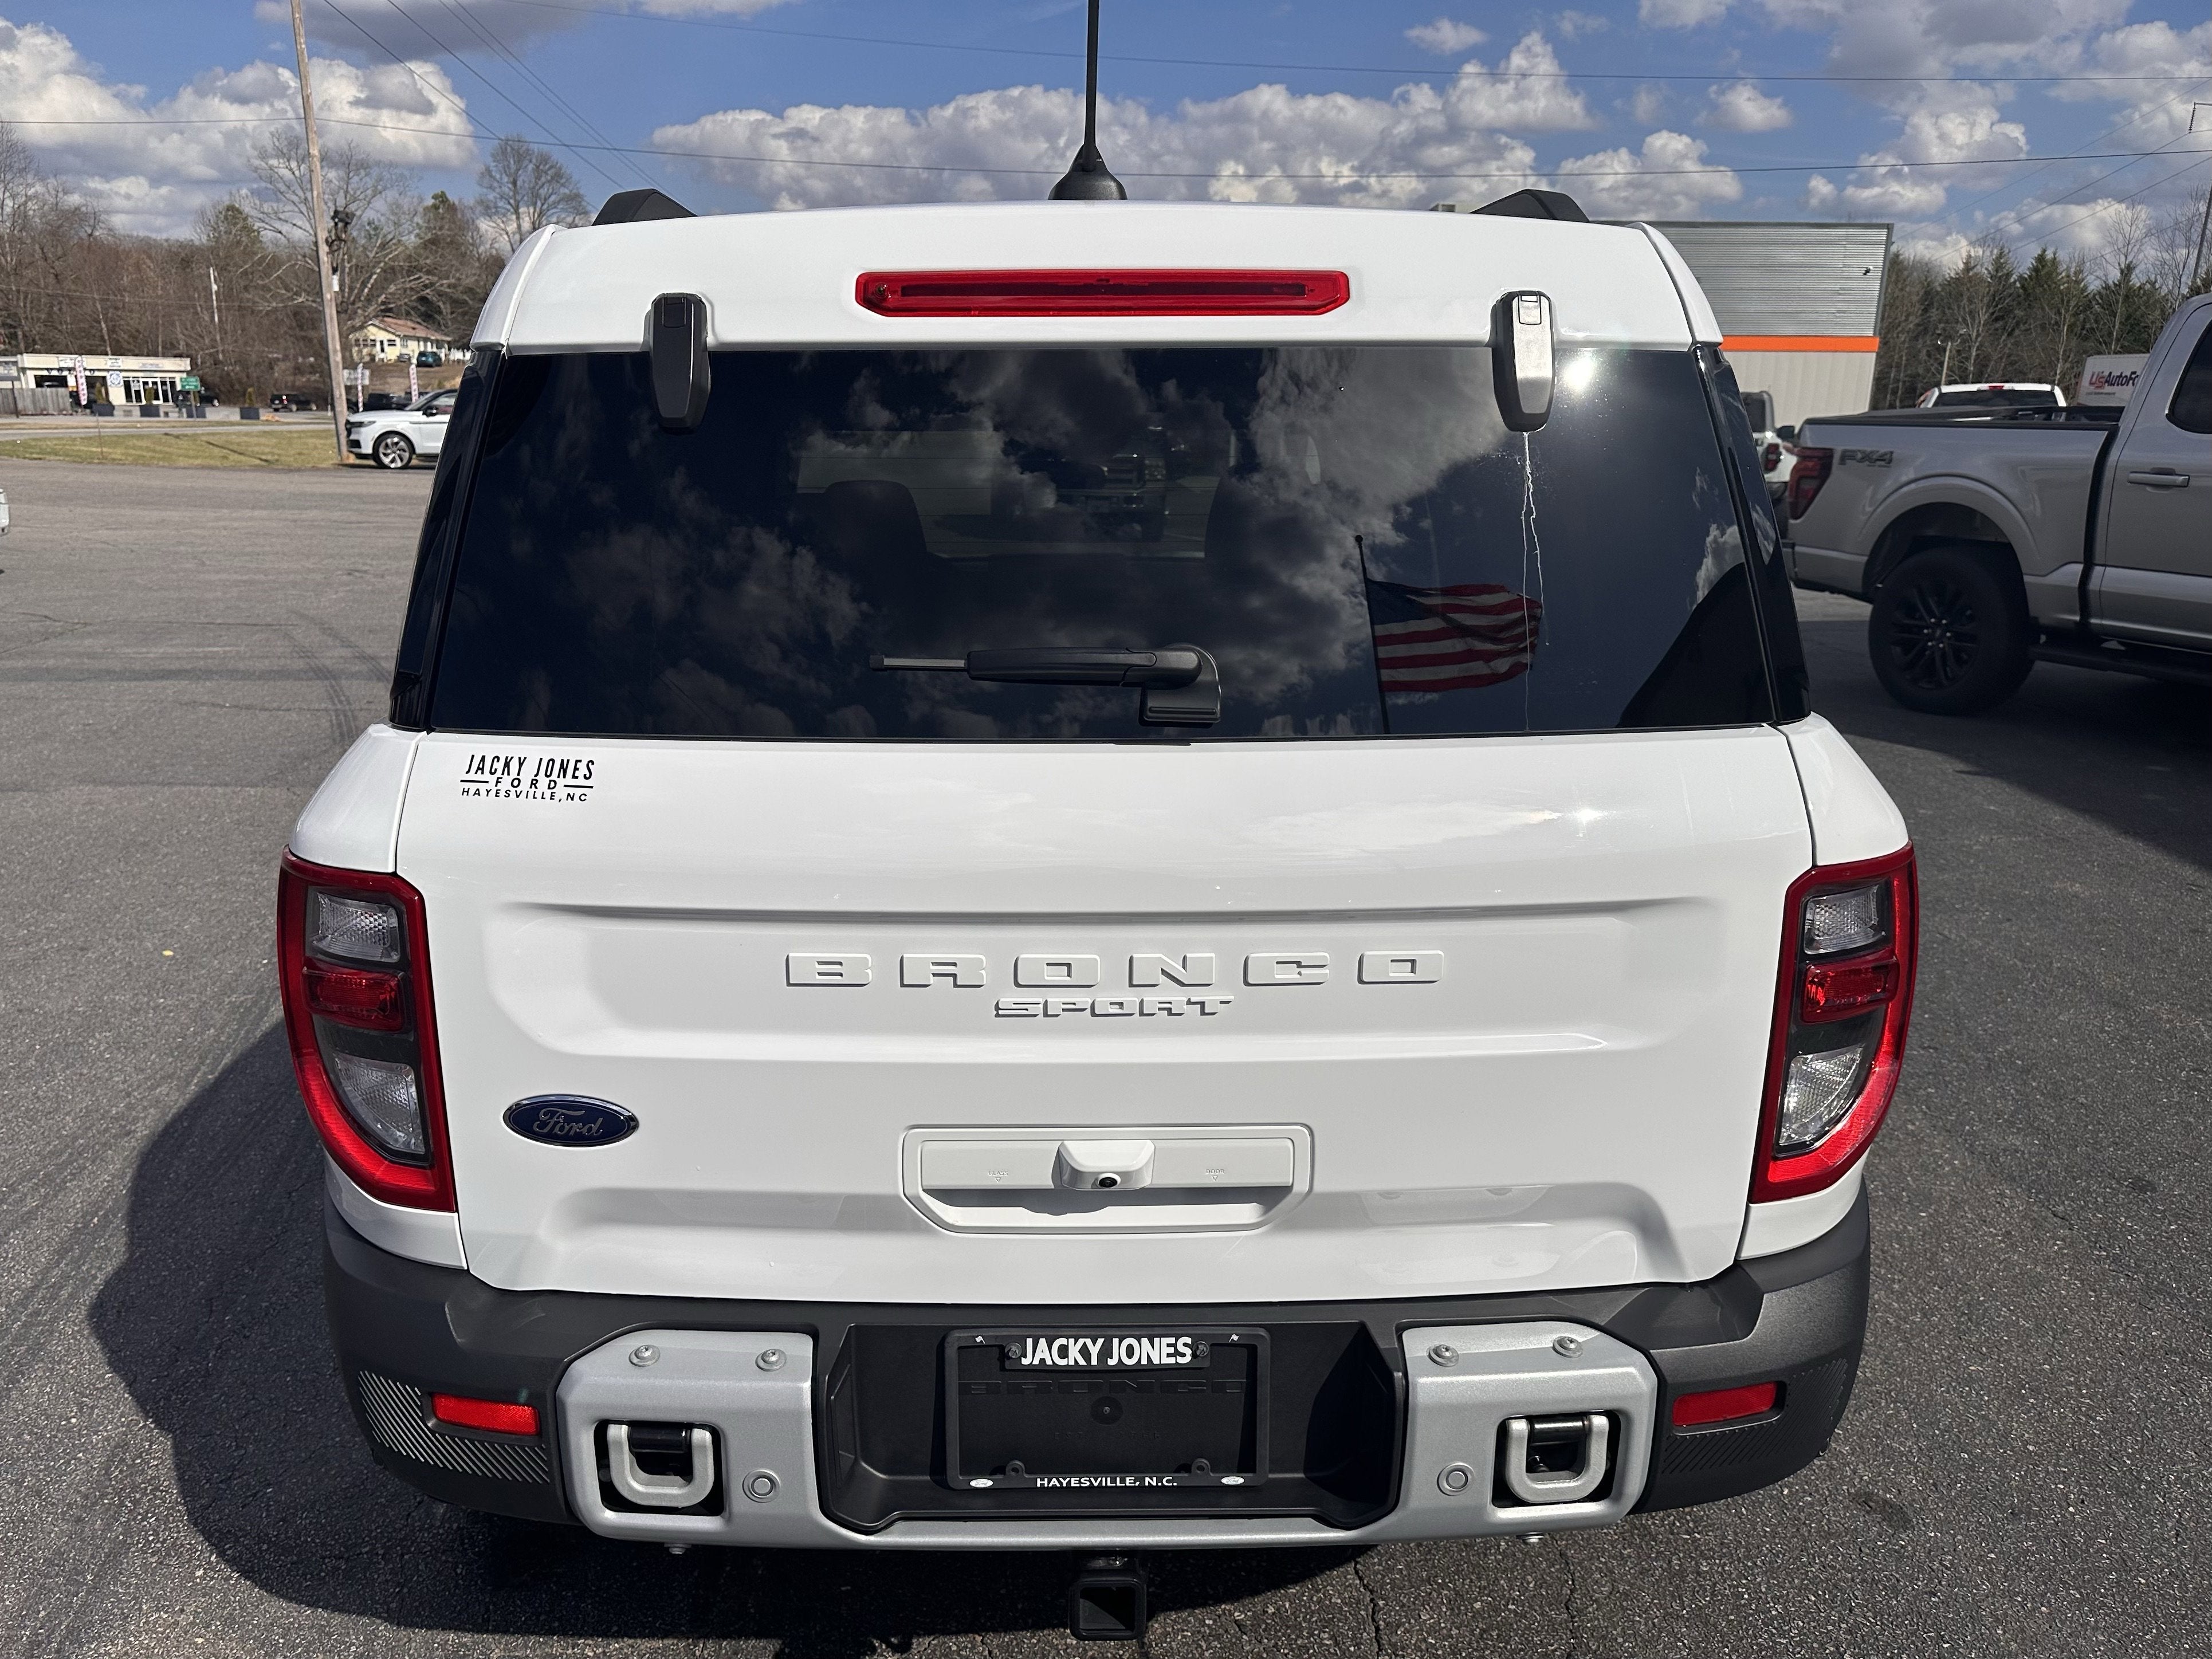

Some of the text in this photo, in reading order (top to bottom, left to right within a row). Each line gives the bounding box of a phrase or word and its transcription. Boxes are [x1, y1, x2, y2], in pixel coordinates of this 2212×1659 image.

[1838, 450, 1894, 465] FX4
[466, 754, 595, 780] JACKY JONES
[494, 777, 557, 790] FORD
[784, 950, 1444, 988] BRONCO
[994, 996, 1235, 1018] SPORT
[533, 1107, 603, 1136] Ford
[1021, 1336, 1193, 1366] JACKY JONES
[958, 1379, 1247, 1395] BRONCO
[1036, 1476, 1177, 1488] HAYESVILLE, N.C.
